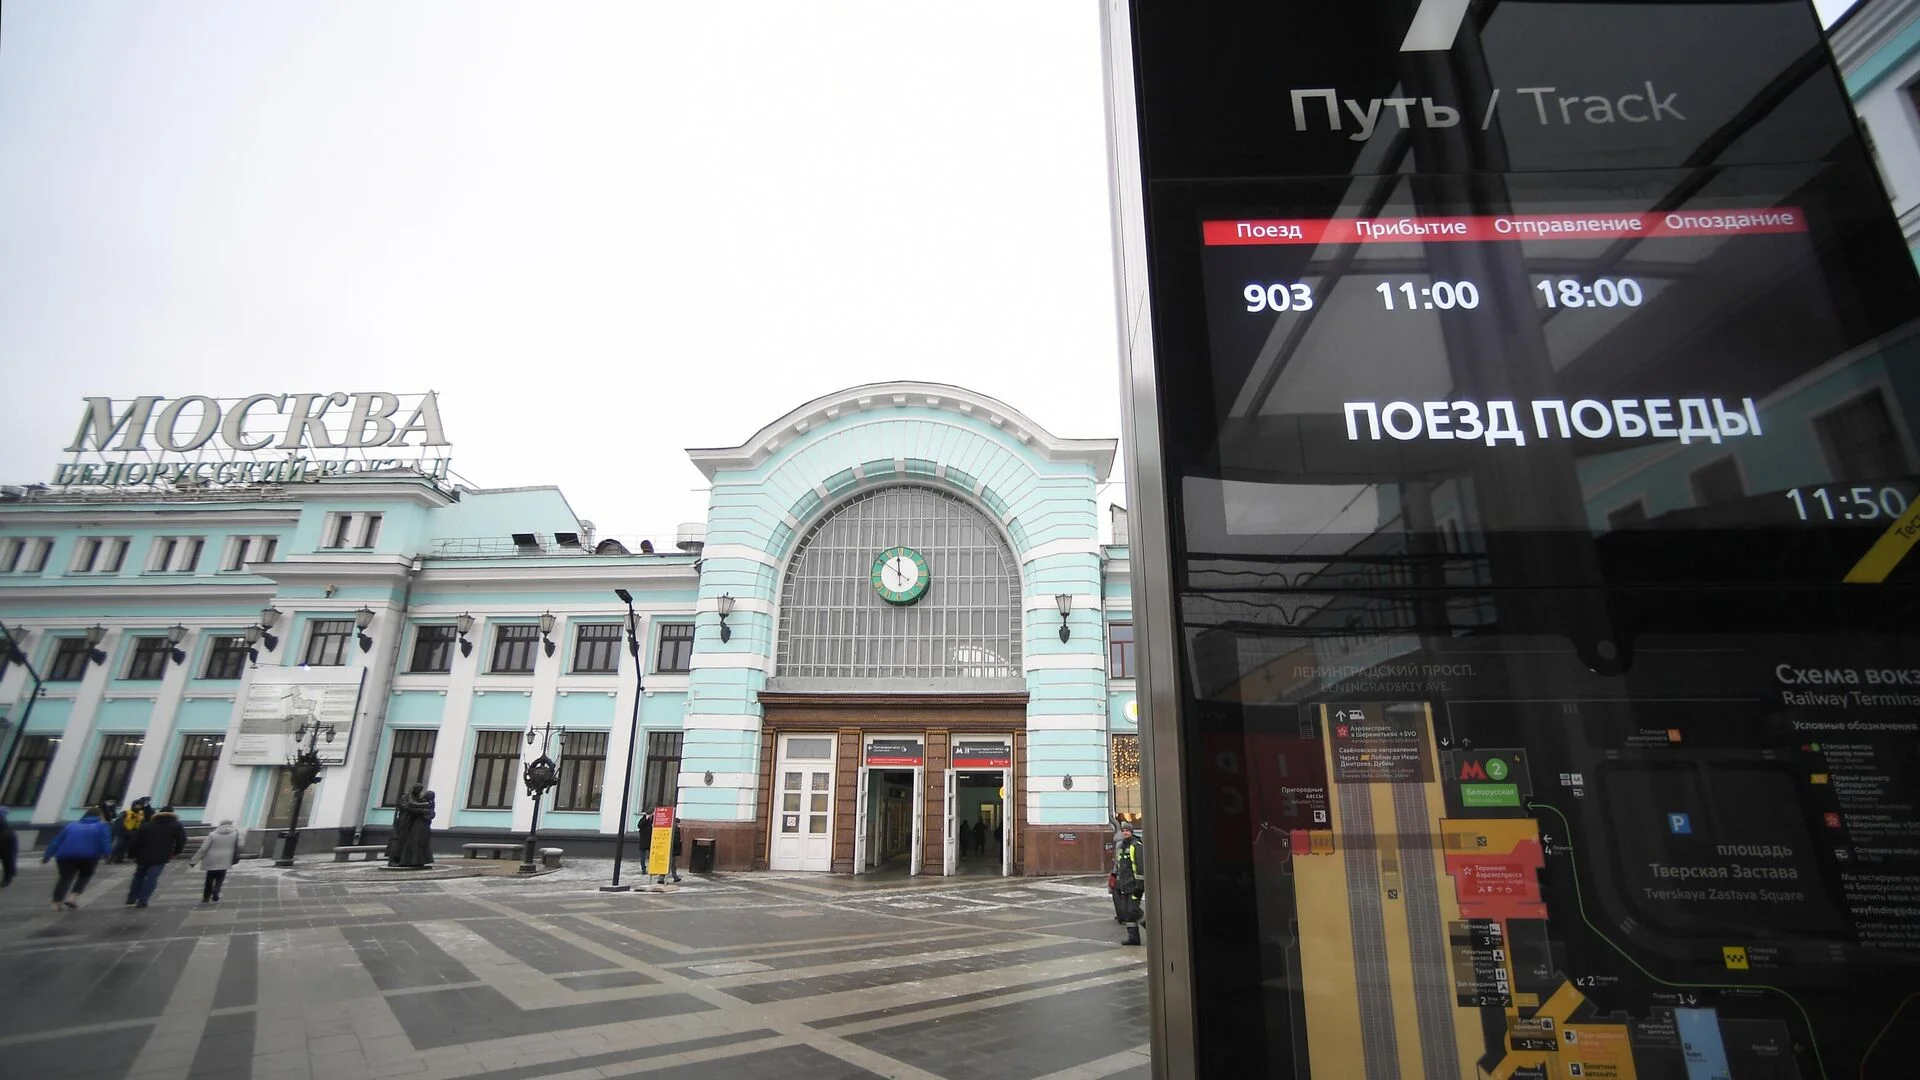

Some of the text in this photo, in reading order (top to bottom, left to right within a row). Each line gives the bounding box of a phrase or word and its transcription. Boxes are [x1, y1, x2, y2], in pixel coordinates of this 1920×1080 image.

[1290, 88, 1461, 142] Путь
[1517, 81, 1687, 125] Track
[1237, 211, 1794, 239] Поезд Прибытие Отправление Опоздание
[1243, 278, 1643, 312] 903 11:00 18:00
[64, 390, 451, 452] МОСКВА
[1342, 397, 1762, 447] ПОЕЗД ПОБЕДЫ
[50, 453, 307, 485] БЕЛОРУССКИЙ
[1785, 487, 1908, 520] 11:50
[1292, 663, 1476, 679] ЛЕНИНГРАДСКИЙ ПРОСП.
[1775, 663, 1860, 685] Схема
[1320, 680, 1424, 693] LENINGRADSKIY
[1782, 690, 1848, 709] Railway
[1792, 720, 1845, 731] Условные
[1492, 762, 1503, 775] 2
[1466, 788, 1514, 797] Белорусская
[1672, 815, 1684, 832] P
[1544, 845, 1552, 855] 4
[1717, 844, 1792, 859] площадь
[1649, 863, 1798, 881] Тверская Застава
[1644, 888, 1804, 904] Tverskaya Zastava Square
[1484, 937, 1490, 945] 3
[1587, 976, 1595, 986] 2
[1480, 997, 1487, 1005] 2
[1678, 993, 1685, 1004] 1
